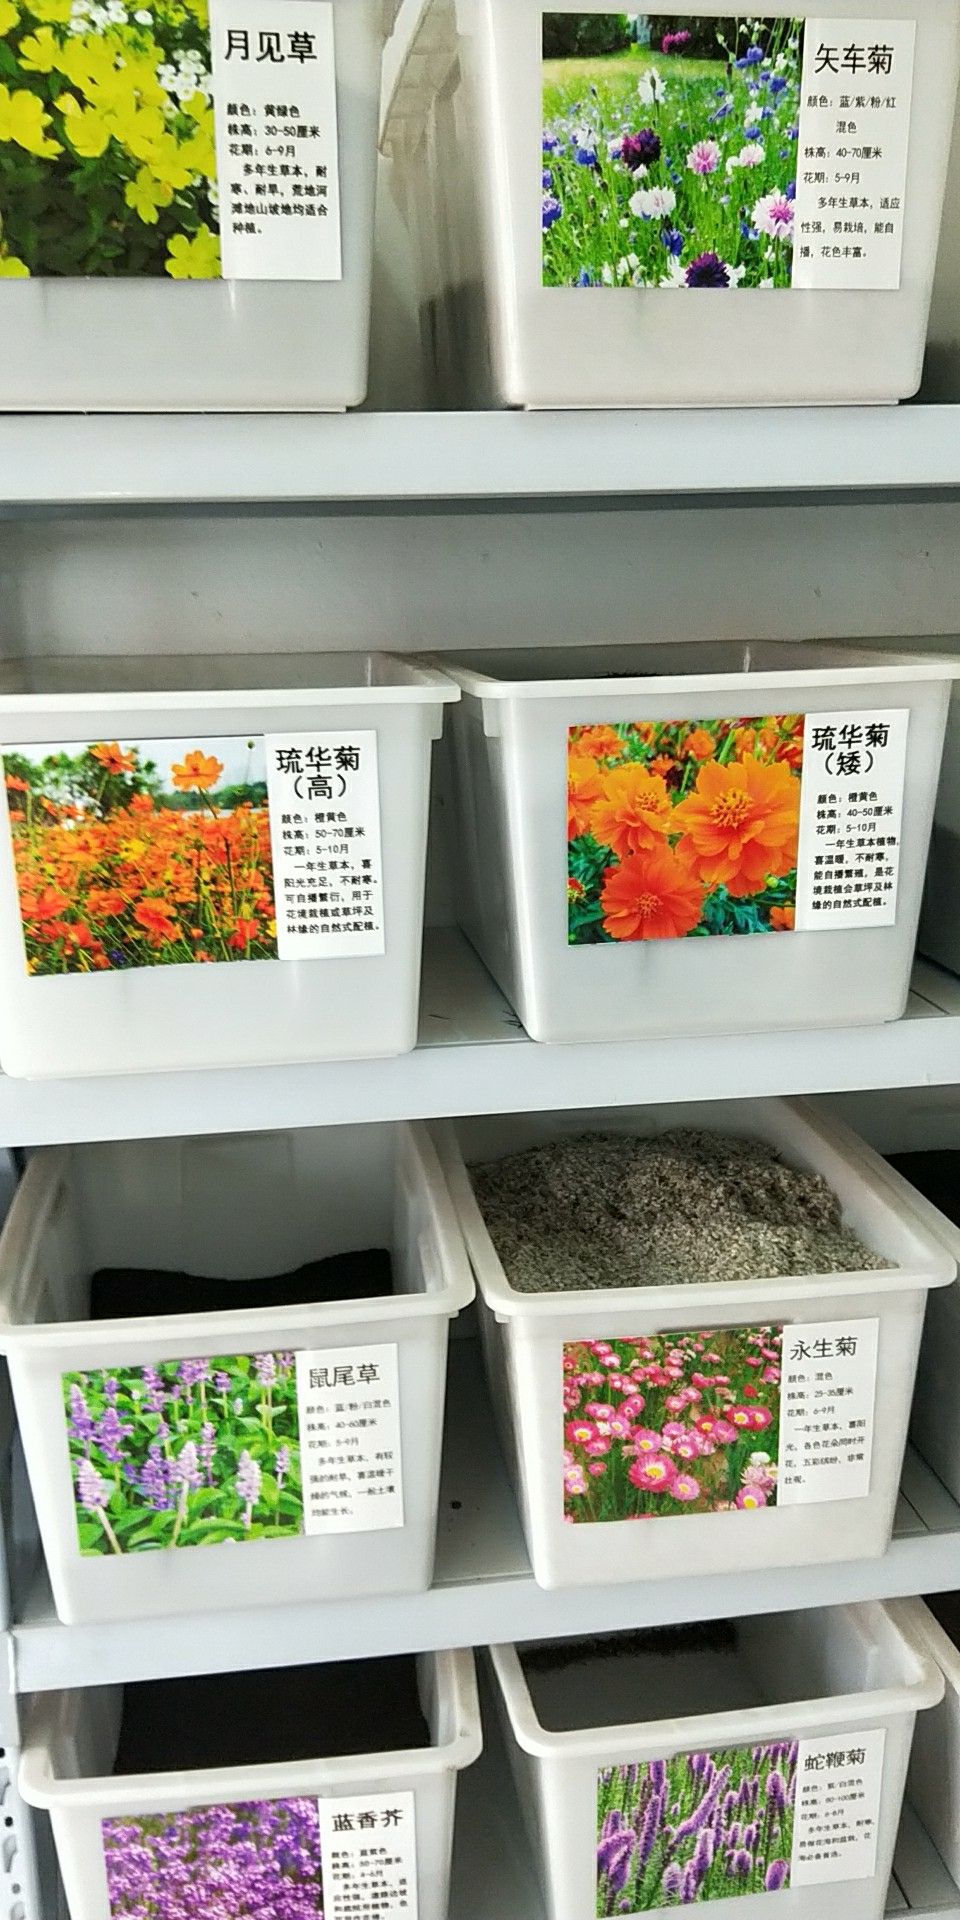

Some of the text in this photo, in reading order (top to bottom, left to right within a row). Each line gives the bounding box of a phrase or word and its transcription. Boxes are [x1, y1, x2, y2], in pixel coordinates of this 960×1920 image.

[224, 29, 317, 63] 月见草
[814, 43, 894, 75] 矢车菊
[807, 95, 896, 109] 颜色：蓝/紫/粉/红
[227, 103, 300, 118] 颜色：黄绿色
[227, 124, 320, 138] 株高：30-50厘米
[835, 121, 857, 134] 混色
[228, 144, 296, 157] 花期：6-9月
[804, 146, 882, 159] 株高：40-70厘米
[803, 172, 860, 184] 花期：5-9月
[817, 196, 900, 210] 多年生草本，适应
[800, 221, 894, 235] 性强，易栽培，能自
[800, 246, 869, 259] 播，花色丰富。
[811, 723, 890, 751] 琉华菊
[275, 746, 360, 774] 琉华菊
[824, 750, 874, 776] （矮）
[294, 773, 347, 801] （高）
[817, 791, 878, 805] 颜色：橙黄色
[281, 811, 347, 825] 颜色：橙黄色
[816, 805, 894, 820] 株高：40-50厘米
[282, 826, 366, 840] 株高：50-70厘米
[815, 822, 877, 836] 花期：5-10月
[283, 843, 349, 856] 花期：5-10月
[790, 1335, 858, 1361] 永生菊
[309, 1363, 380, 1388] 鼠尾草
[803, 1748, 867, 1772] 蛇鞭菊
[331, 1809, 404, 1832] 蓝香芥
